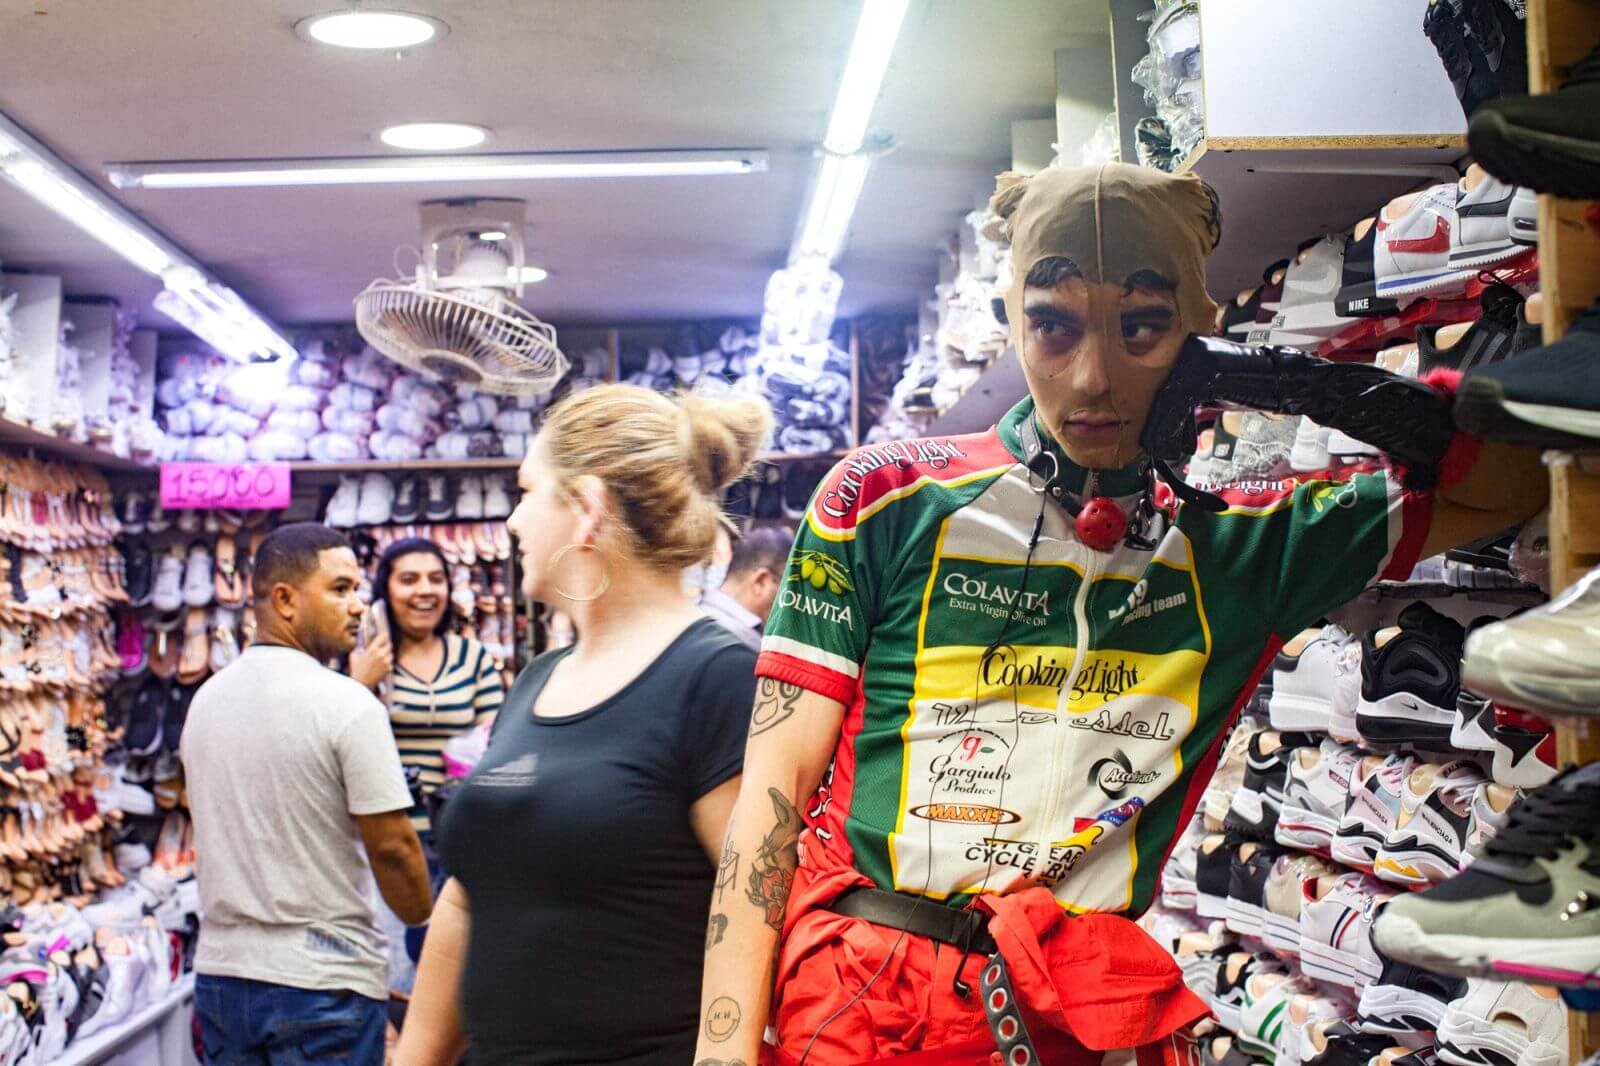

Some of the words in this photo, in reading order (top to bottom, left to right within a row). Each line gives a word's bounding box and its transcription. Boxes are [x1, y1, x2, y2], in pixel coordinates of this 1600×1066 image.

[1348, 298, 1369, 312] NIKE
[943, 573, 1050, 616] COLAVITA
[1153, 592, 1187, 613] team
[949, 598, 976, 611] Extra
[980, 603, 1009, 618] Virgin
[928, 755, 1012, 783] Gargiulo
[942, 778, 996, 795] Produce
[925, 803, 1001, 823] MAXXIS
